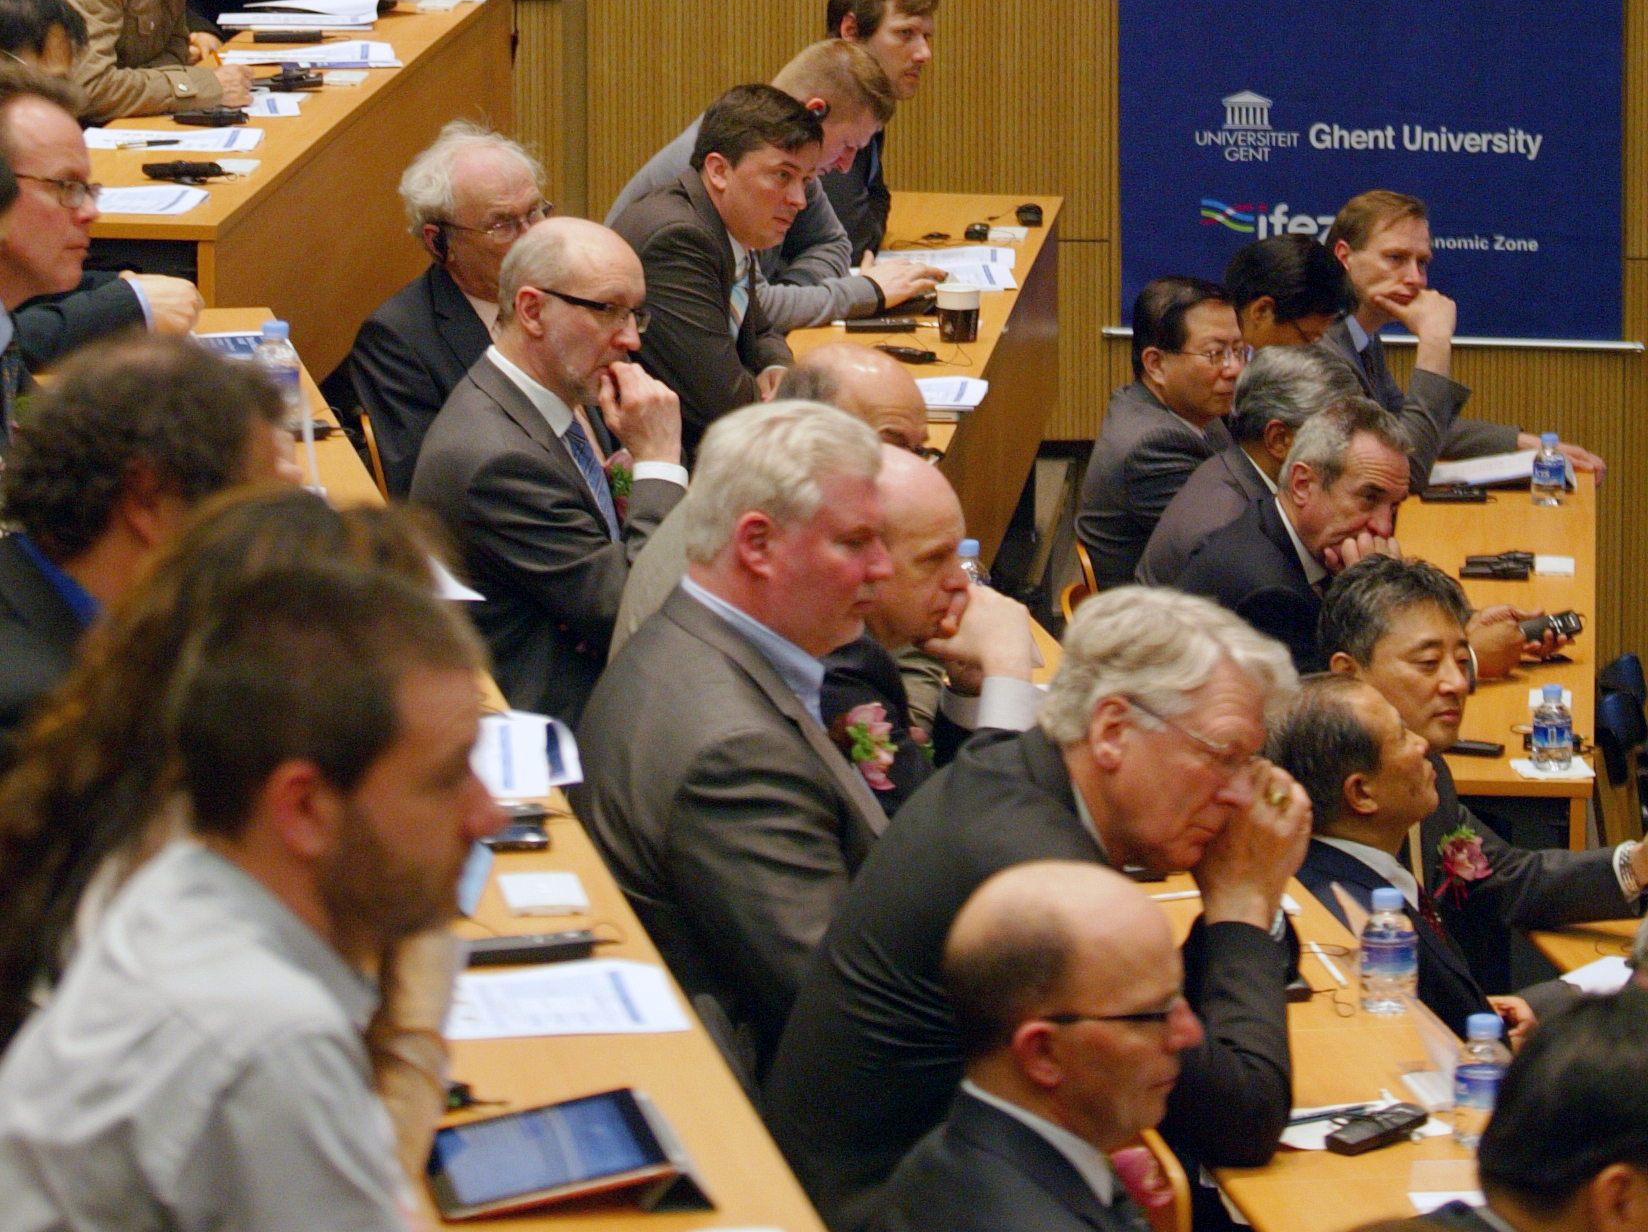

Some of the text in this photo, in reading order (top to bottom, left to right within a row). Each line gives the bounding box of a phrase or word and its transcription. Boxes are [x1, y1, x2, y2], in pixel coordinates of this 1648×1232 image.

[1194, 130, 1300, 148] UNIVERSITEIT
[1308, 122, 1543, 161] Ghent University
[1223, 146, 1271, 163] GENT
[1431, 234, 1539, 253] nomic Zone
